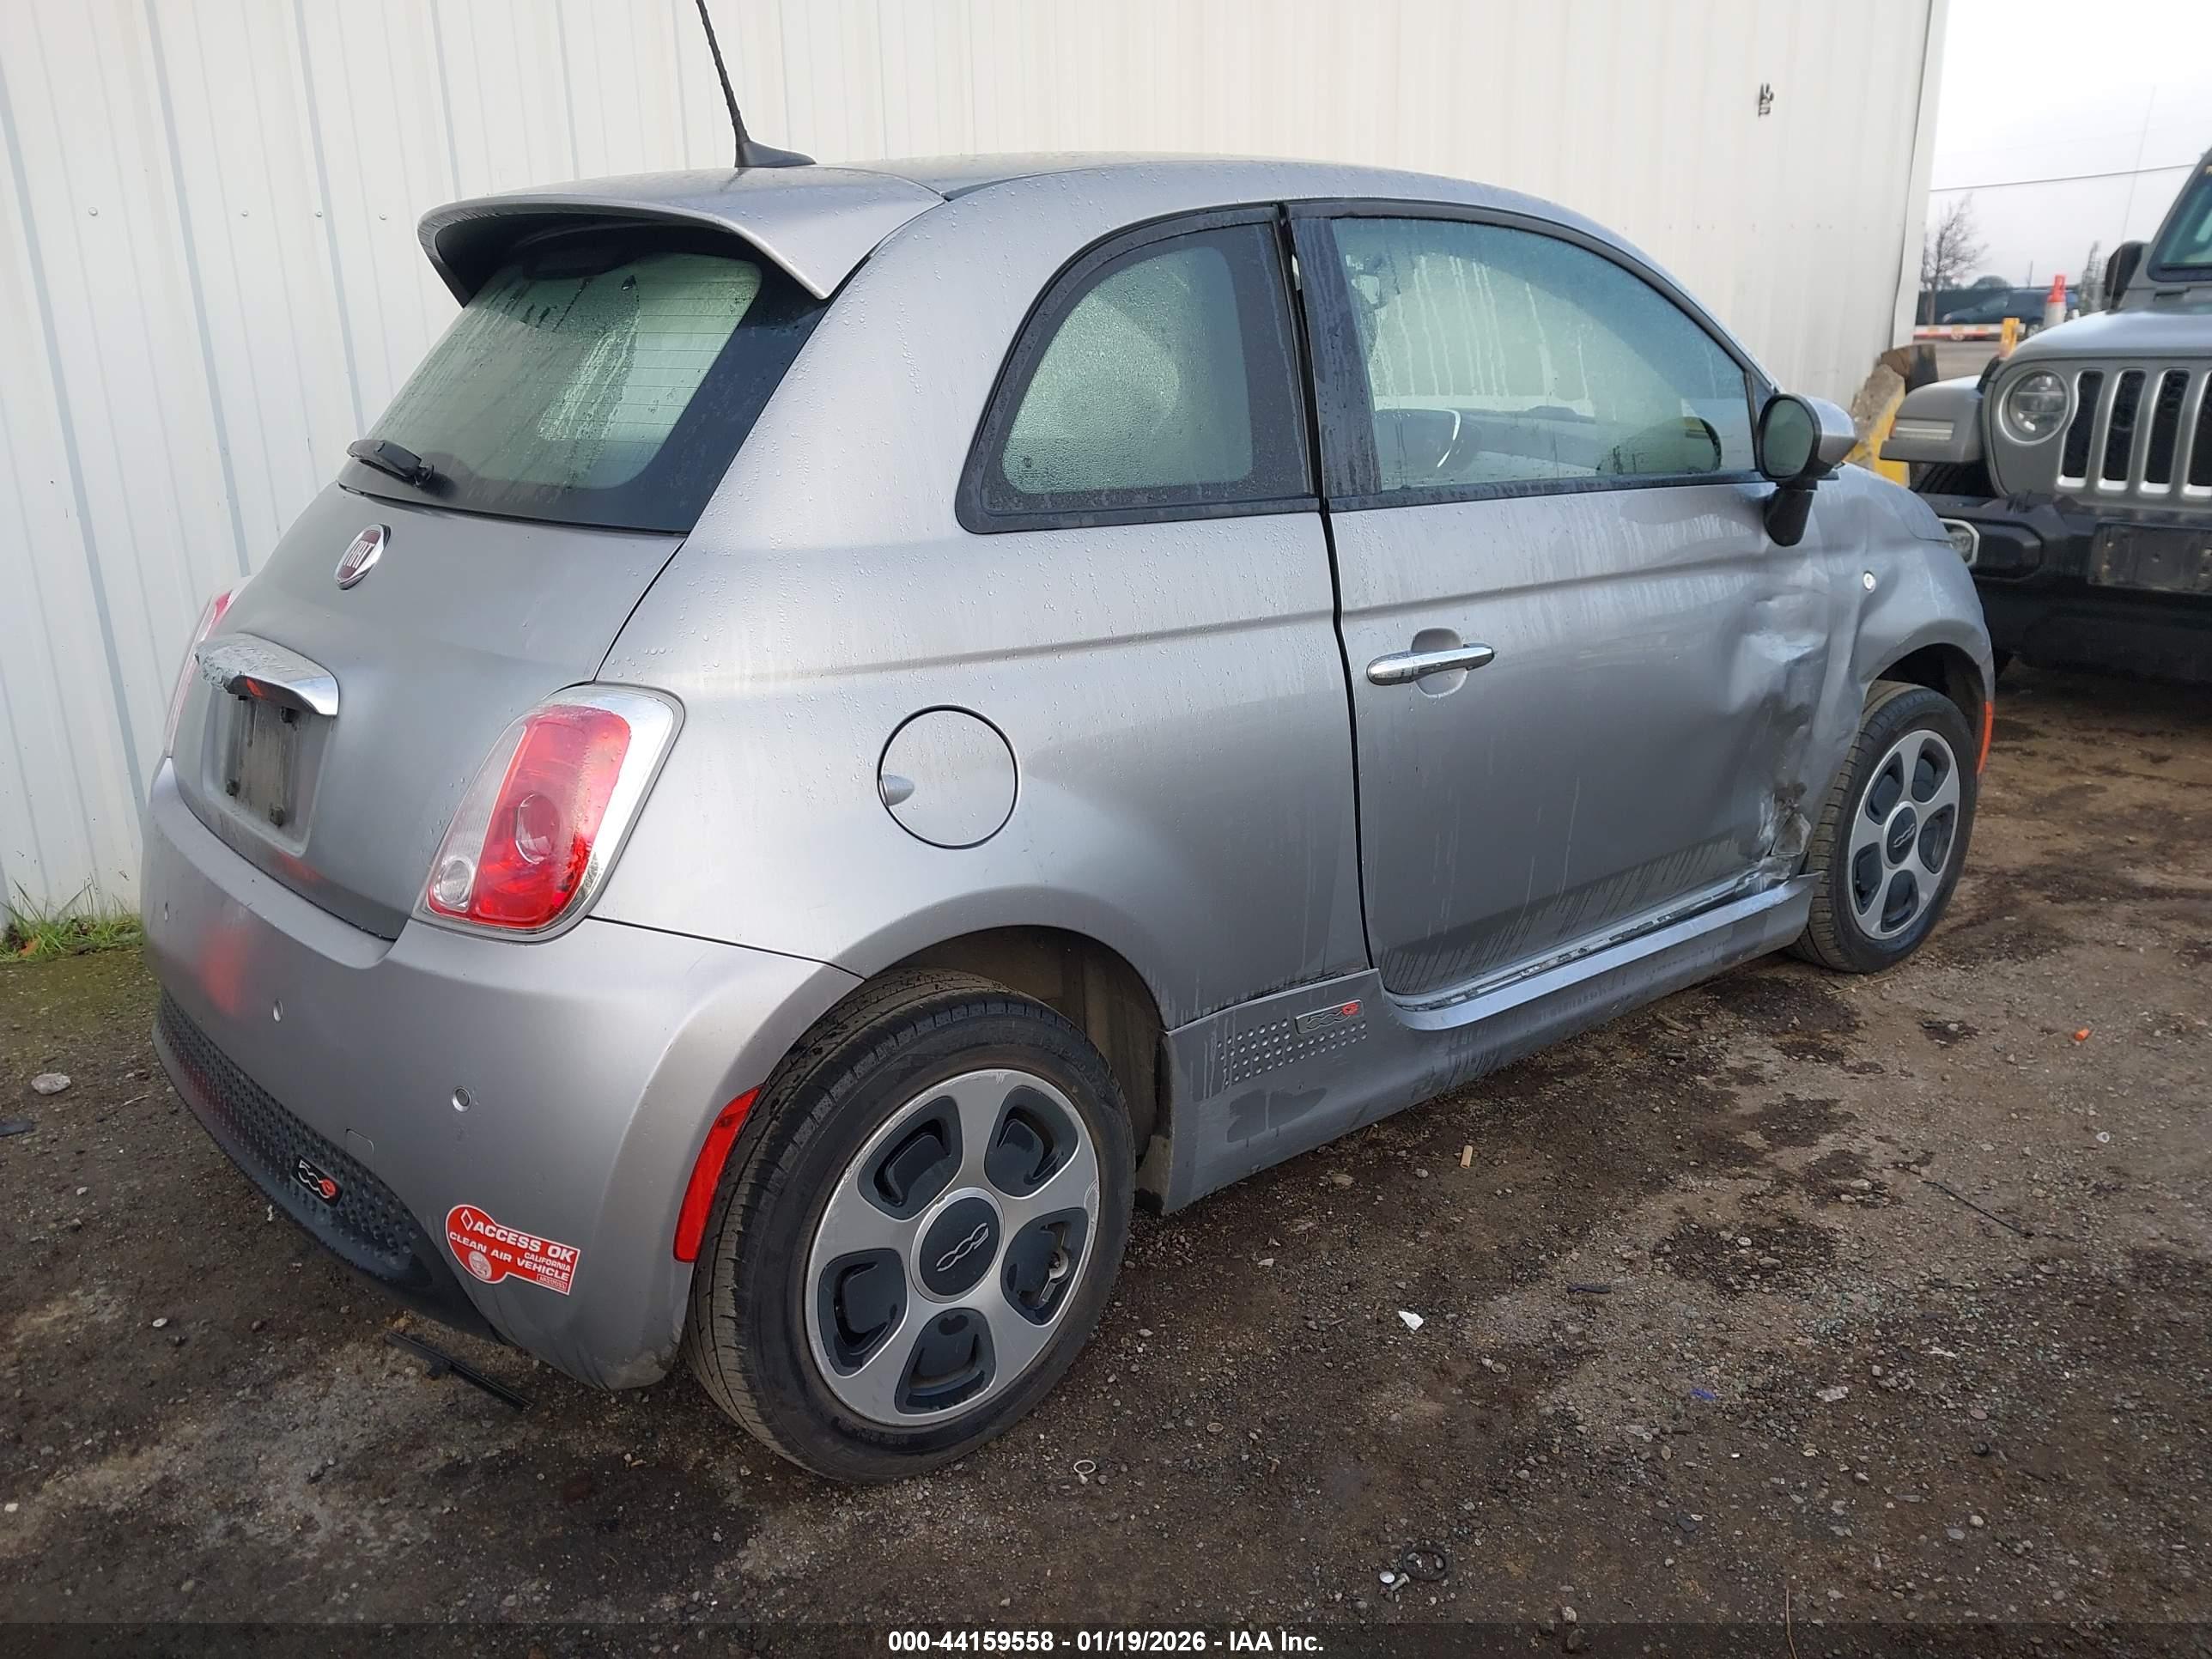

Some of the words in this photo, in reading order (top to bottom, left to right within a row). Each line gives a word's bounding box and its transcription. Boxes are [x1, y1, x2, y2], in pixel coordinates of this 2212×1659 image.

[343, 539, 375, 569] FIAT
[449, 1231, 487, 1253] CLEAN
[490, 1249, 512, 1263] AIR
[516, 1257, 570, 1282] VEHICLE
[473, 1220, 541, 1253] ACCESS
[547, 1245, 575, 1263] OK
[524, 1251, 571, 1273] CALIFORNIA
